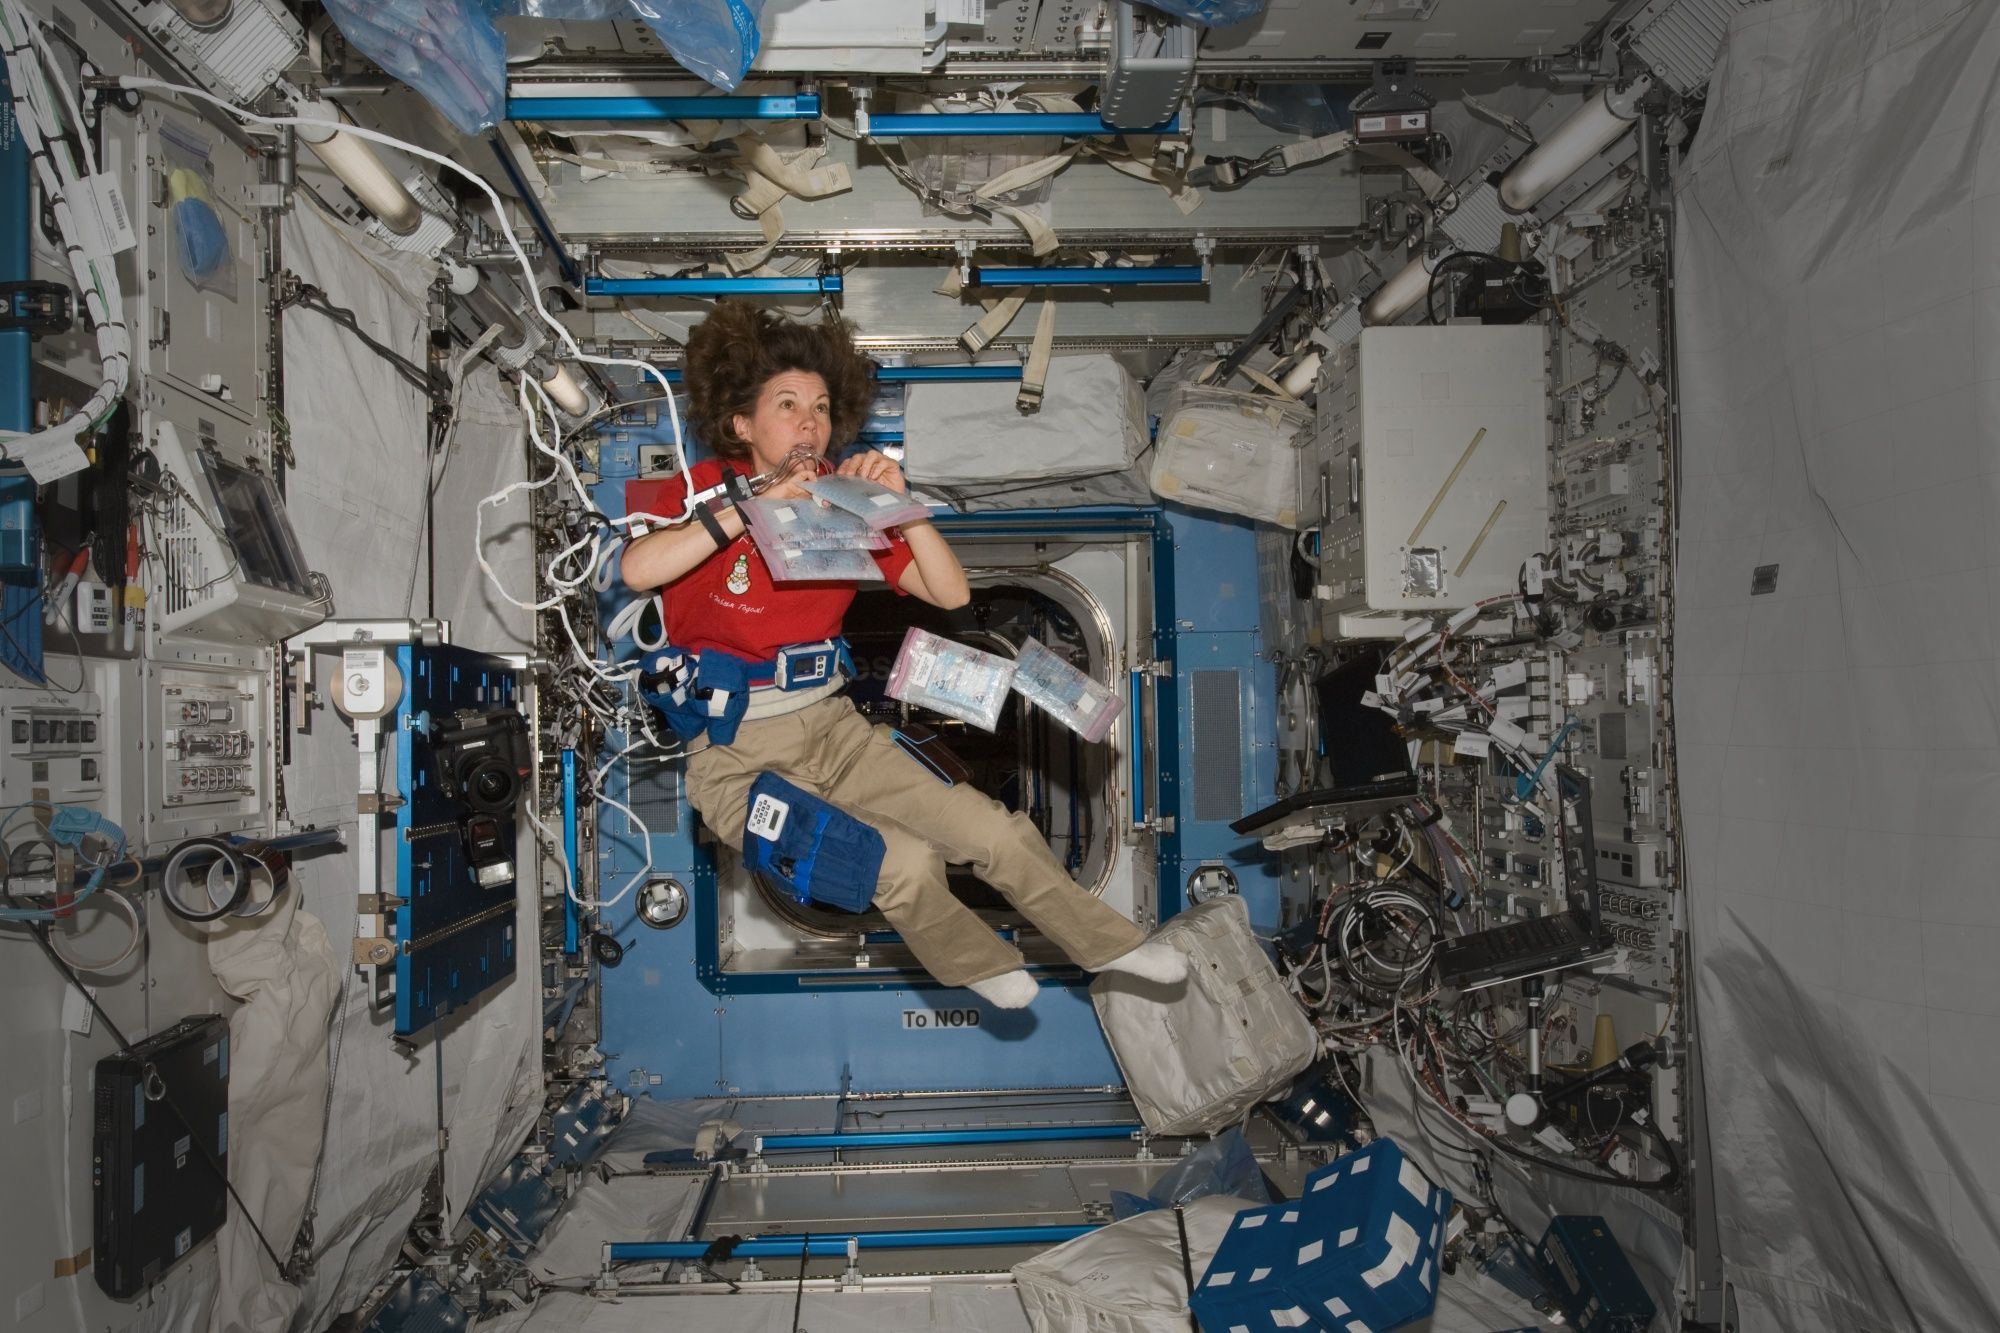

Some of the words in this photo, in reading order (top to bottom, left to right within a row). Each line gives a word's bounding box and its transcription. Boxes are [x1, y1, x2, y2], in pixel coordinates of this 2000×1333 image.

[1407, 117, 1419, 127] 4
[903, 1010, 927, 1028] To
[935, 1009, 980, 1028] NOD
